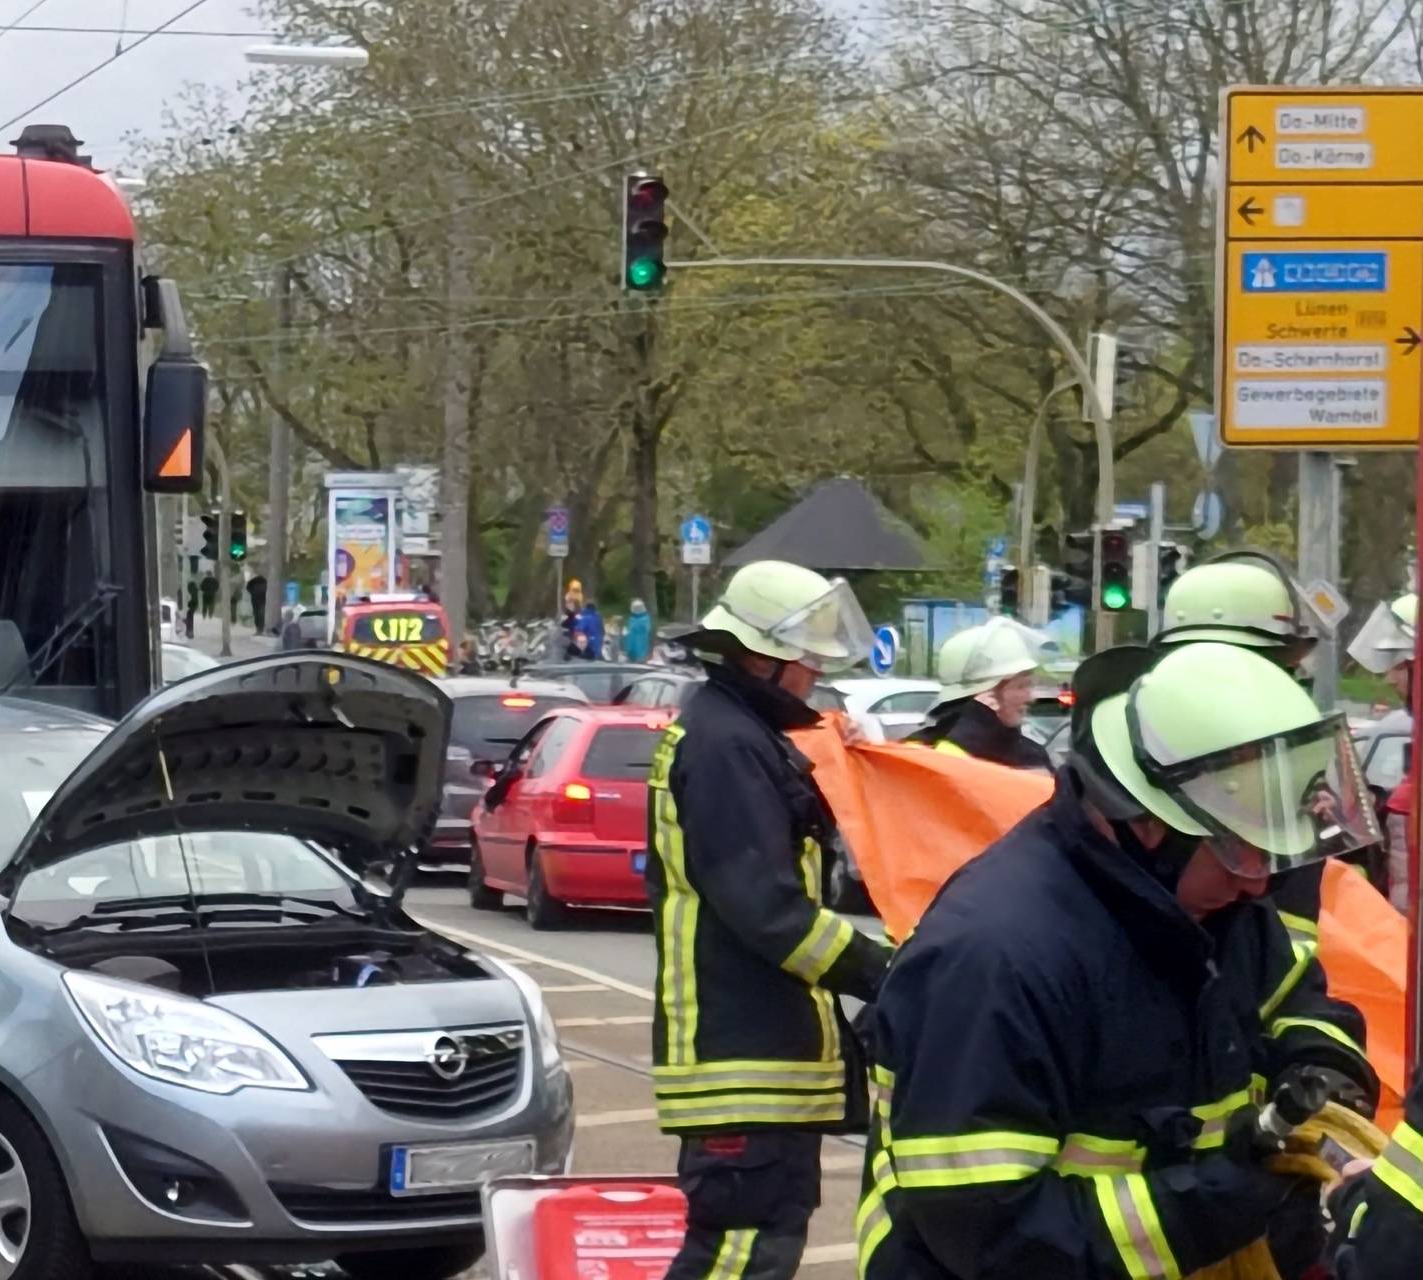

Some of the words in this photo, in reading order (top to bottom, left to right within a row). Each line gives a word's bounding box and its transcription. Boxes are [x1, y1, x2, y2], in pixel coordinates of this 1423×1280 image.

[1266, 323, 1348, 339] Schwerte
[1238, 386, 1380, 405] Gewerbegebiete
[1309, 409, 1379, 424] Wambel
[389, 618, 424, 642] 112
